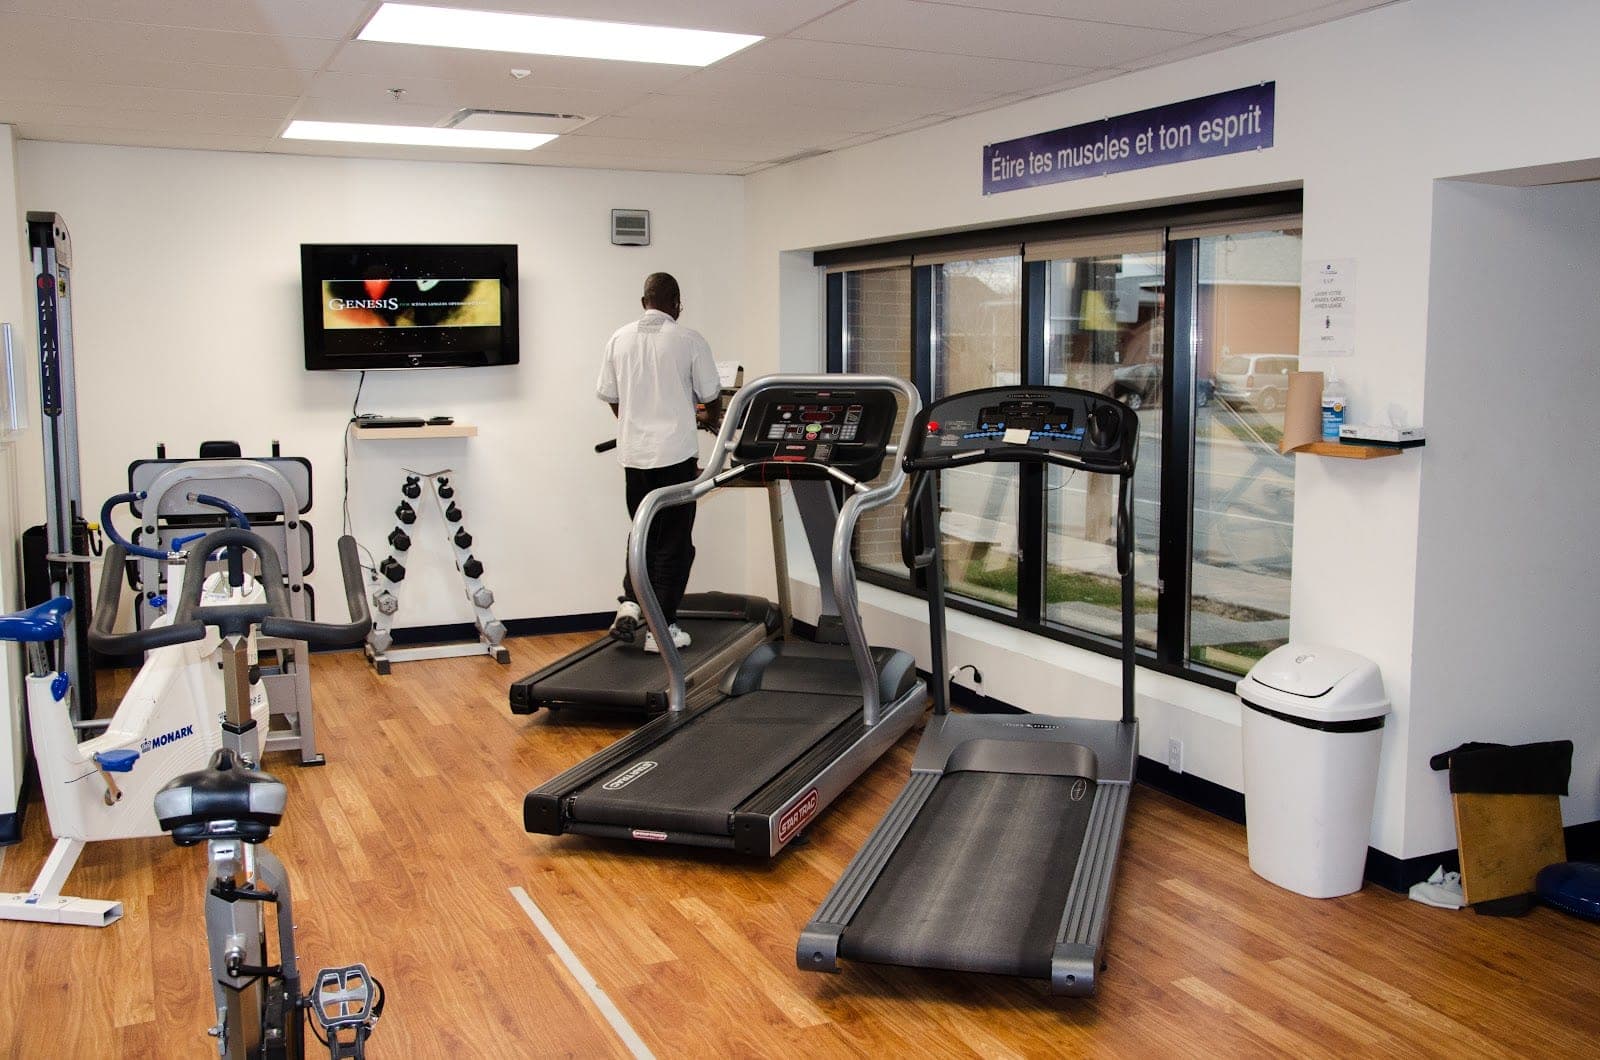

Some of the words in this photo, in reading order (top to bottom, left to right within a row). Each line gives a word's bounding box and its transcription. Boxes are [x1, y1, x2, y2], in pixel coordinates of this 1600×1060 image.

[991, 150, 1025, 182] Étire
[1029, 152, 1053, 175] tes
[1057, 134, 1130, 170] muscles
[1135, 127, 1154, 155] et
[1158, 123, 1192, 148] ton
[1198, 104, 1262, 147] esprit
[328, 297, 399, 311] GENESIS
[152, 724, 194, 750] MONARK
[780, 811, 799, 836] STAR
[799, 796, 816, 821] TRAC
